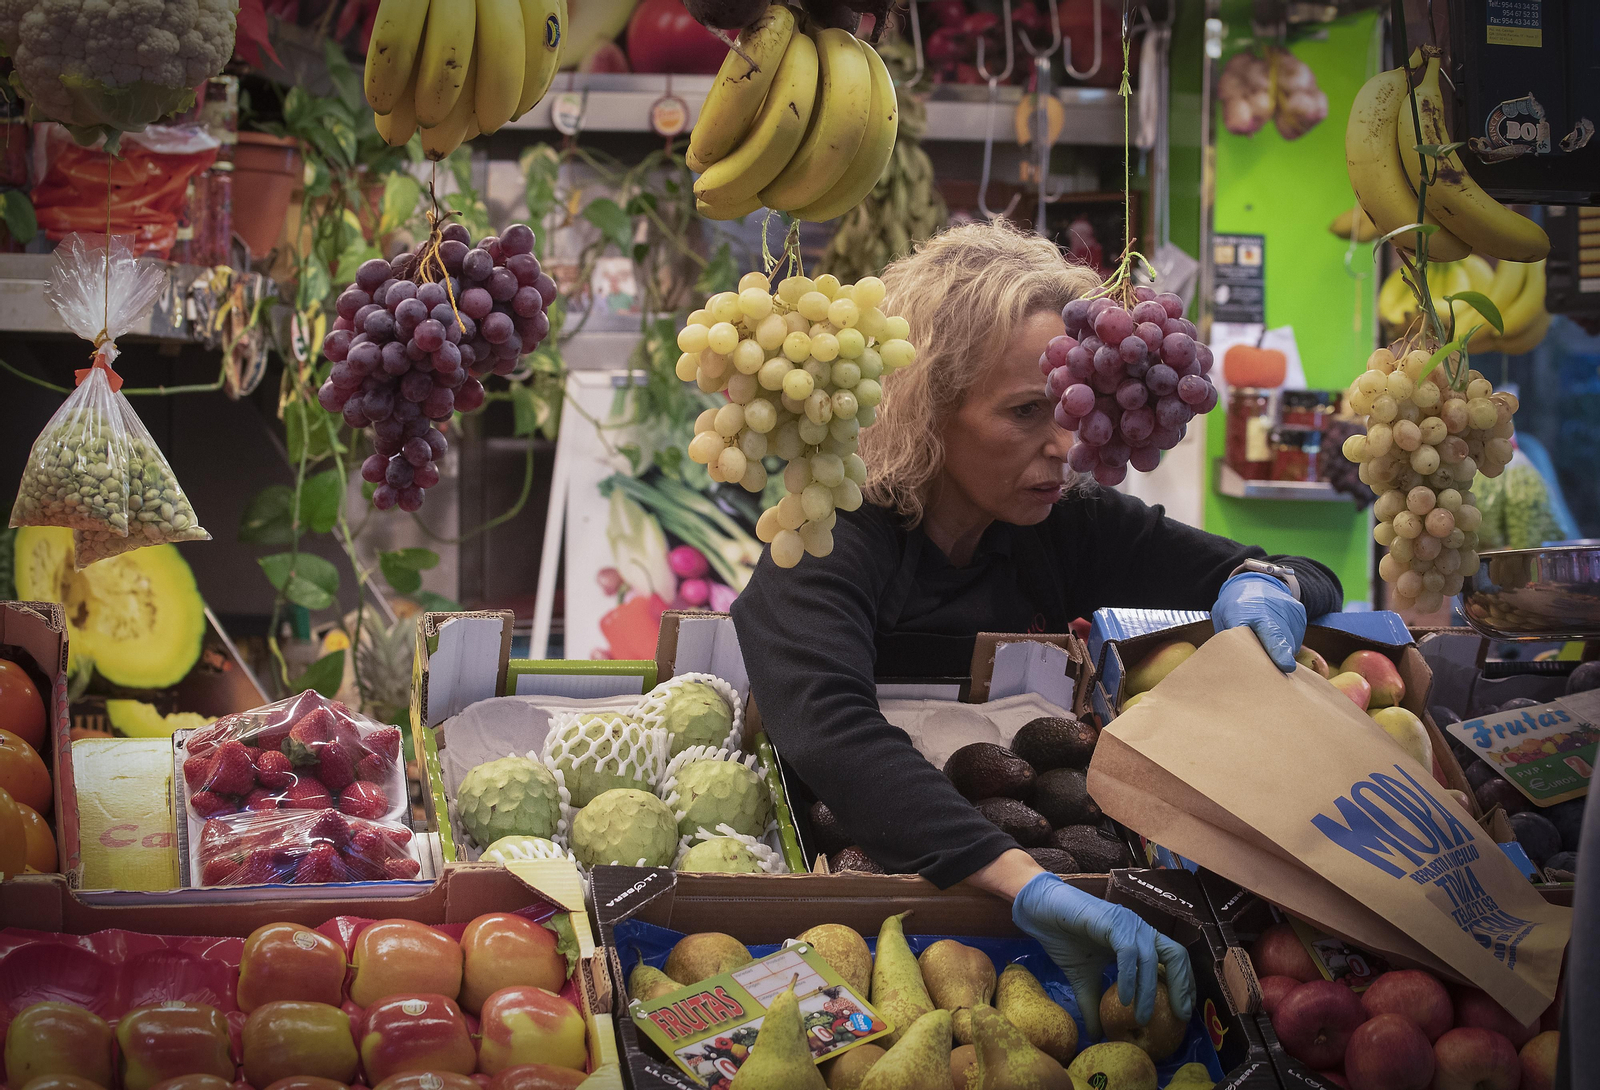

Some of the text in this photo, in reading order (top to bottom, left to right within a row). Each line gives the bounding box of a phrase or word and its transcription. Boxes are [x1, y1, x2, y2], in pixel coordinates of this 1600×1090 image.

[1463, 710, 1571, 749] Frutas
[1516, 766, 1544, 778] P.V.P.
[1409, 857, 1450, 885] REPARTO
[647, 986, 748, 1042] FRUTAS
